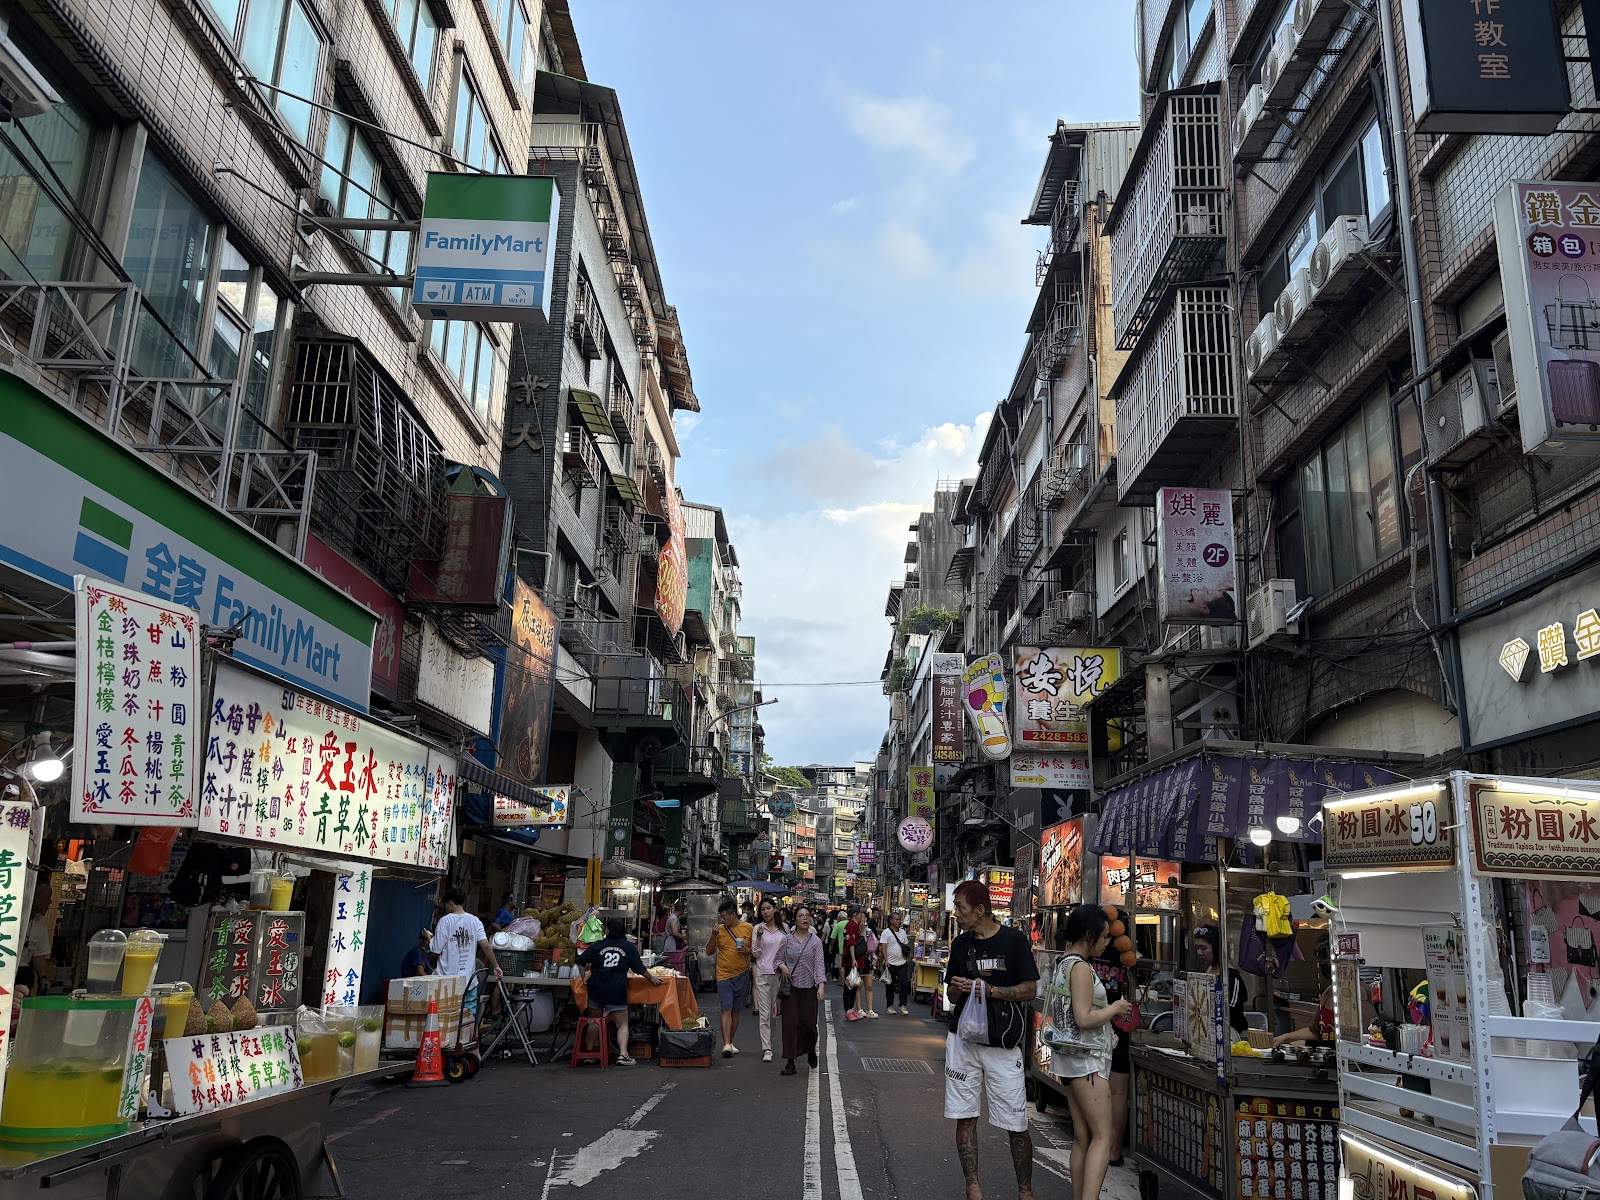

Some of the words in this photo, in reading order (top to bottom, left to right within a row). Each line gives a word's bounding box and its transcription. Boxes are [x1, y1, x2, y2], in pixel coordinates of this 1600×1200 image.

[425, 231, 543, 256] FamilyMart
[466, 286, 491, 301] ATM
[1207, 547, 1226, 563] 2F
[141, 542, 207, 610] 全家
[212, 574, 341, 682] FamilyMart
[96, 609, 116, 714] 金桔檸檬
[121, 617, 141, 717] 珍珠奶茶
[146, 623, 164, 722] 甘蔗汁
[170, 630, 188, 726] 山粉圓
[1028, 699, 1088, 722] 養生
[1032, 731, 1088, 742] 2428-583
[92, 722, 114, 804] 愛玉冰
[118, 726, 141, 805] 冬瓜茶
[145, 731, 164, 806] 楊桃汁
[168, 733, 186, 808] 青草茶
[202, 697, 226, 804] 冬瓜茶
[219, 704, 244, 819] 梅子汁
[237, 702, 263, 821] 甘蔗汁
[284, 737, 297, 807] 紅茶
[316, 730, 378, 801] 愛玉冰
[0, 803, 31, 831] 攤
[219, 819, 229, 833] 50
[313, 791, 371, 850] 青草茶
[1337, 803, 1408, 841] 粉圓冰
[1409, 800, 1437, 846] 50
[1486, 807, 1496, 836] 古早味
[1487, 841, 1514, 850] Traditional
[1515, 842, 1534, 852] Tapioca
[1499, 806, 1600, 844] 粉圓冰
[285, 932, 298, 942] 50
[331, 873, 352, 953] 愛玉冰
[350, 870, 369, 952] 青草茶
[207, 917, 230, 1000] 青草茶
[229, 917, 253, 998] 愛玉冰
[260, 918, 289, 1008] 愛玉冰
[603, 952, 620, 968] 22
[192, 1033, 238, 1059] 甘蔗汁
[240, 1032, 286, 1058] 愛玉檸檬
[248, 1058, 291, 1091] 青草茶
[284, 1027, 302, 1088] 冬瓜茶
[945, 1067, 968, 1082] RIGINAL
[191, 1078, 248, 1111] 珍珠奶茶
[1238, 1119, 1253, 1197] 麻辣魚蛋
[1255, 1120, 1270, 1198] 原味魚蛋
